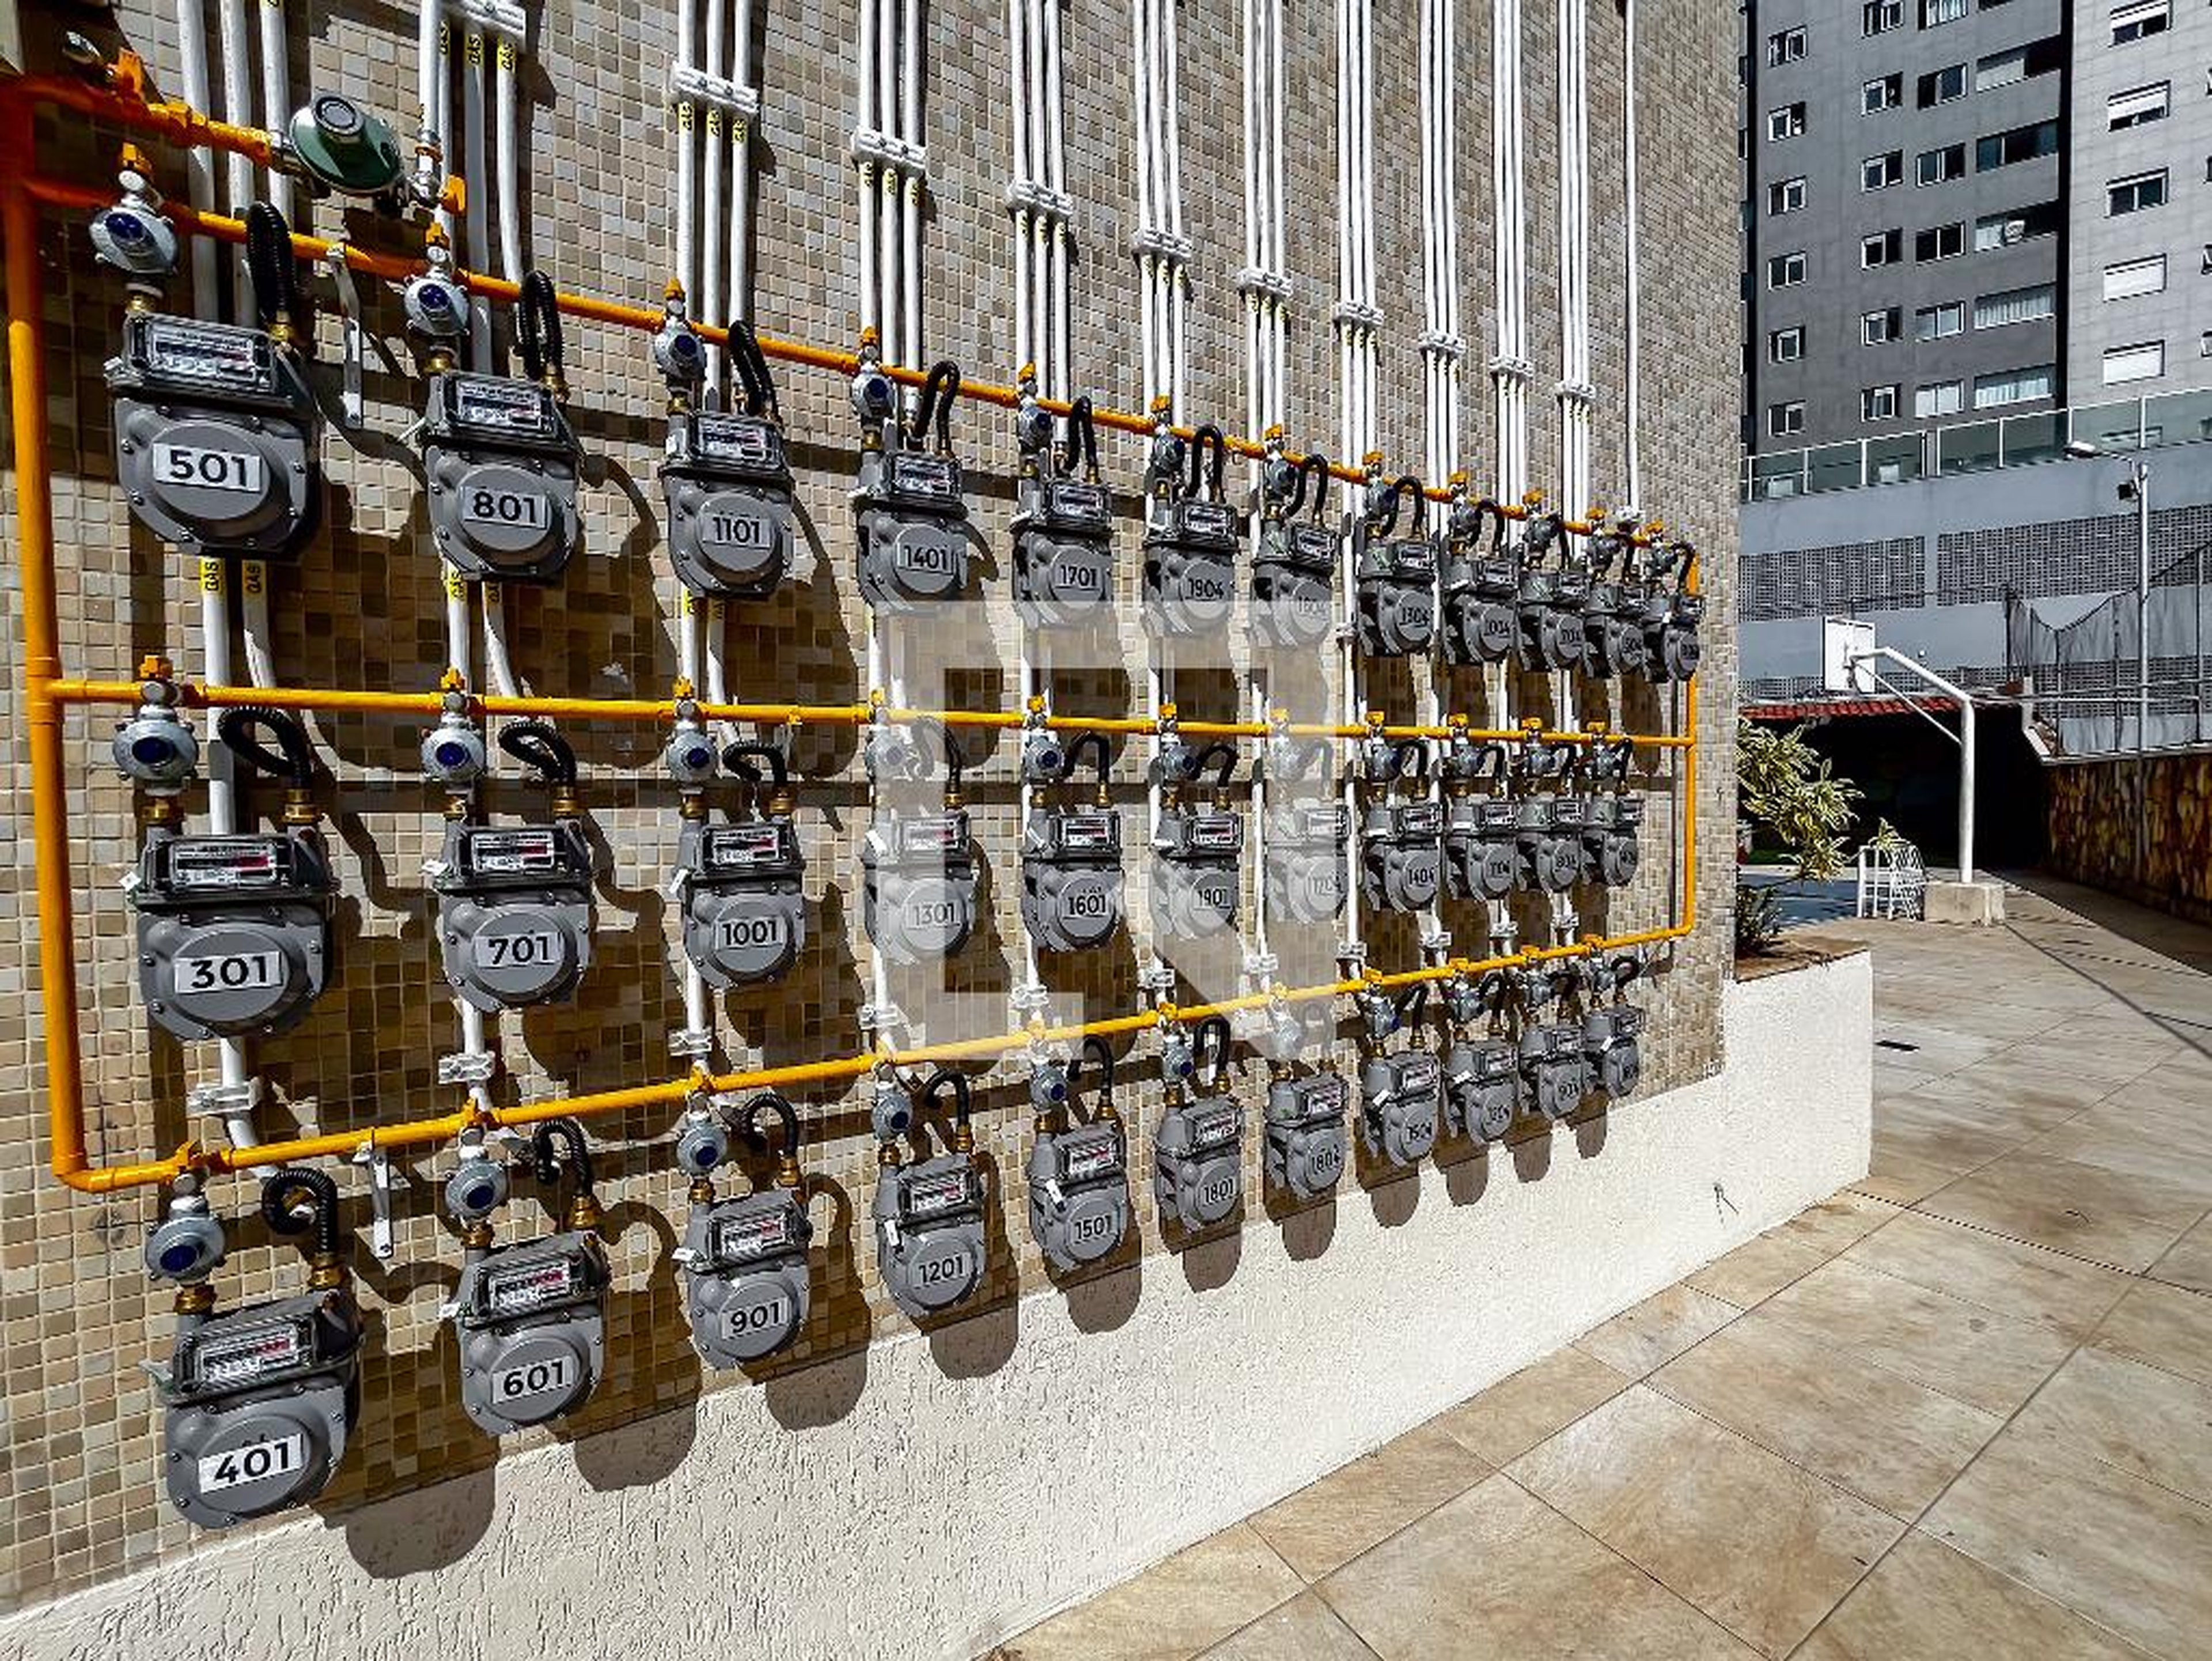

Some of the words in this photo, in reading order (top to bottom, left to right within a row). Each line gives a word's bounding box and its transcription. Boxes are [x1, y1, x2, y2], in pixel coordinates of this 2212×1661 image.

[169, 449, 247, 486] 501
[473, 491, 536, 524] 801
[713, 517, 760, 543] 1101
[904, 545, 946, 569] 1401
[1061, 565, 1097, 586] 1701
[1188, 578, 1224, 599] 1904
[1068, 895, 1106, 915] 1601
[1198, 888, 1228, 907] 1901
[915, 903, 954, 926] 1301
[723, 921, 776, 945] 1001
[488, 936, 548, 964] 701
[191, 956, 268, 989] 301
[1203, 1179, 1234, 1205] 1801
[1075, 1216, 1111, 1239] 1501
[919, 1255, 964, 1283] 1201
[731, 1302, 779, 1333] 901
[503, 1361, 563, 1396] 601
[214, 1442, 288, 1483] 401
